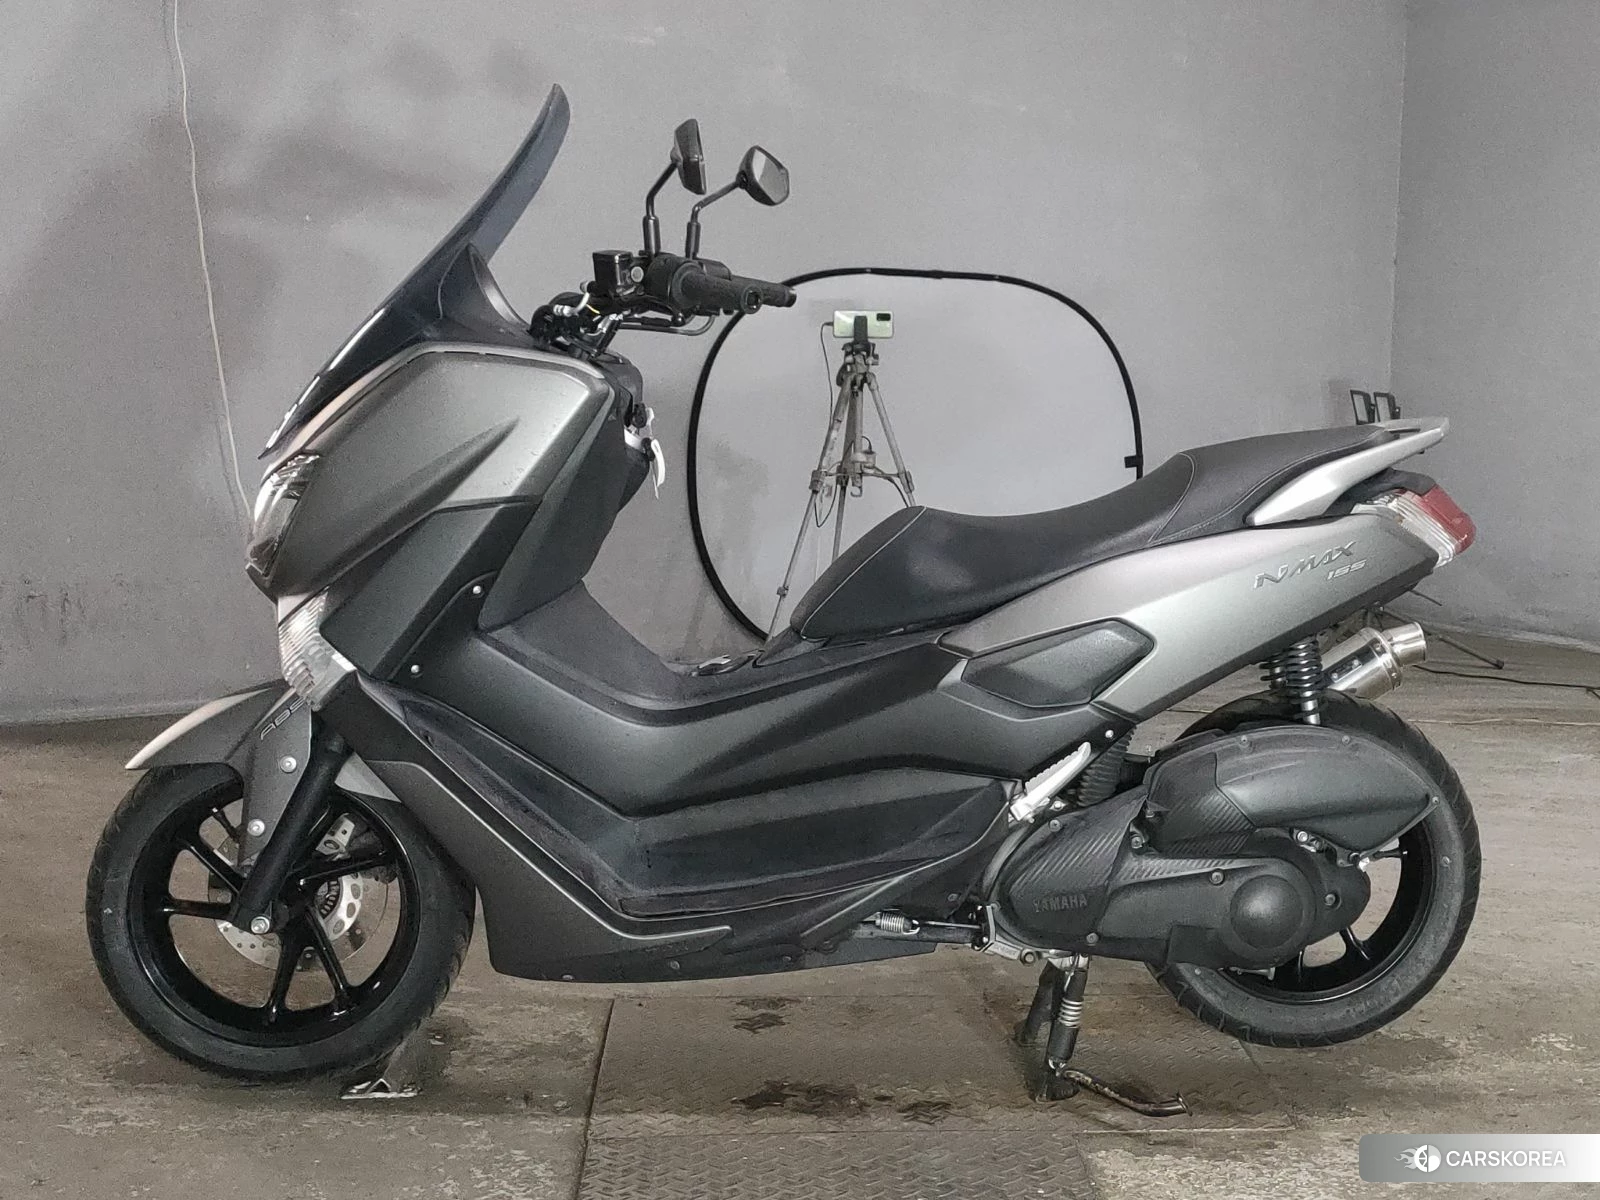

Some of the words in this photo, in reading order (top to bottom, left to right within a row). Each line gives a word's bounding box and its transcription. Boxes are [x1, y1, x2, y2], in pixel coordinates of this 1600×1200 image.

[1253, 541, 1357, 589] NMAX
[260, 695, 306, 740] ABS
[1032, 894, 1088, 912] YAMAHA
